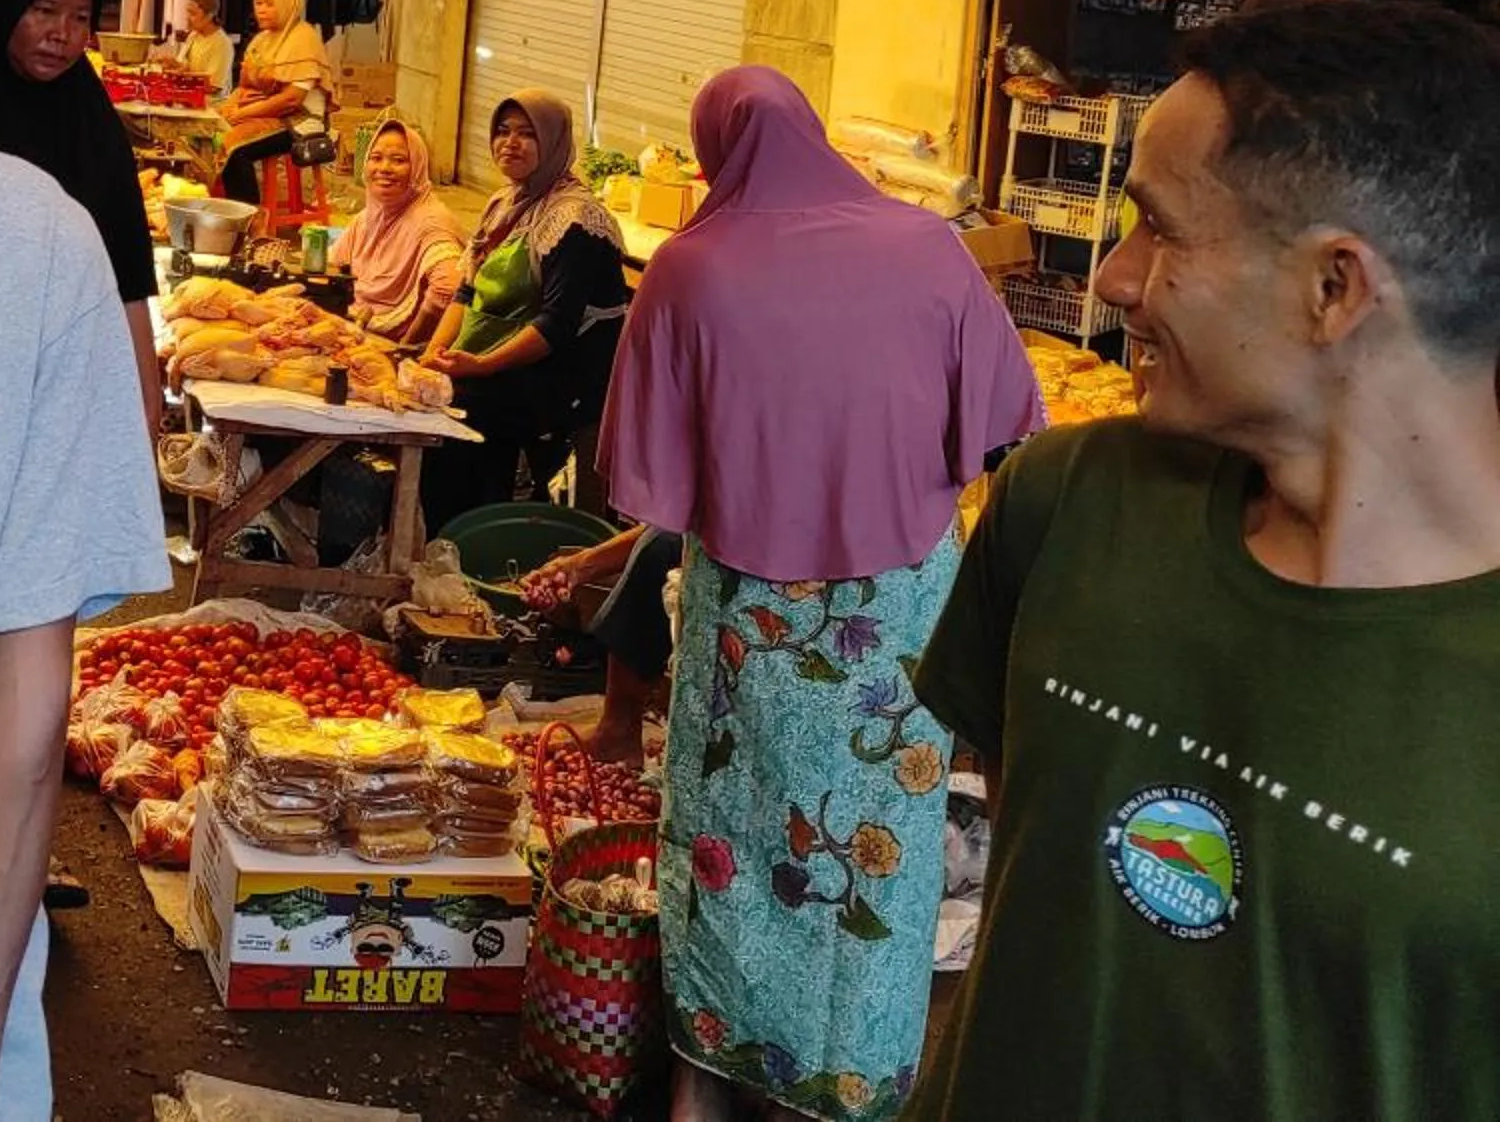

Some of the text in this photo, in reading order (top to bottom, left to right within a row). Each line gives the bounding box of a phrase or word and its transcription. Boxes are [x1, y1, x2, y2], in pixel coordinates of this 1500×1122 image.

[1044, 677, 1414, 868] RINJANI VIA AIK BERIK
[1117, 787, 1169, 821] RINJANI
[1126, 850, 1220, 919] TASTURA
[303, 967, 447, 1004] BARET
